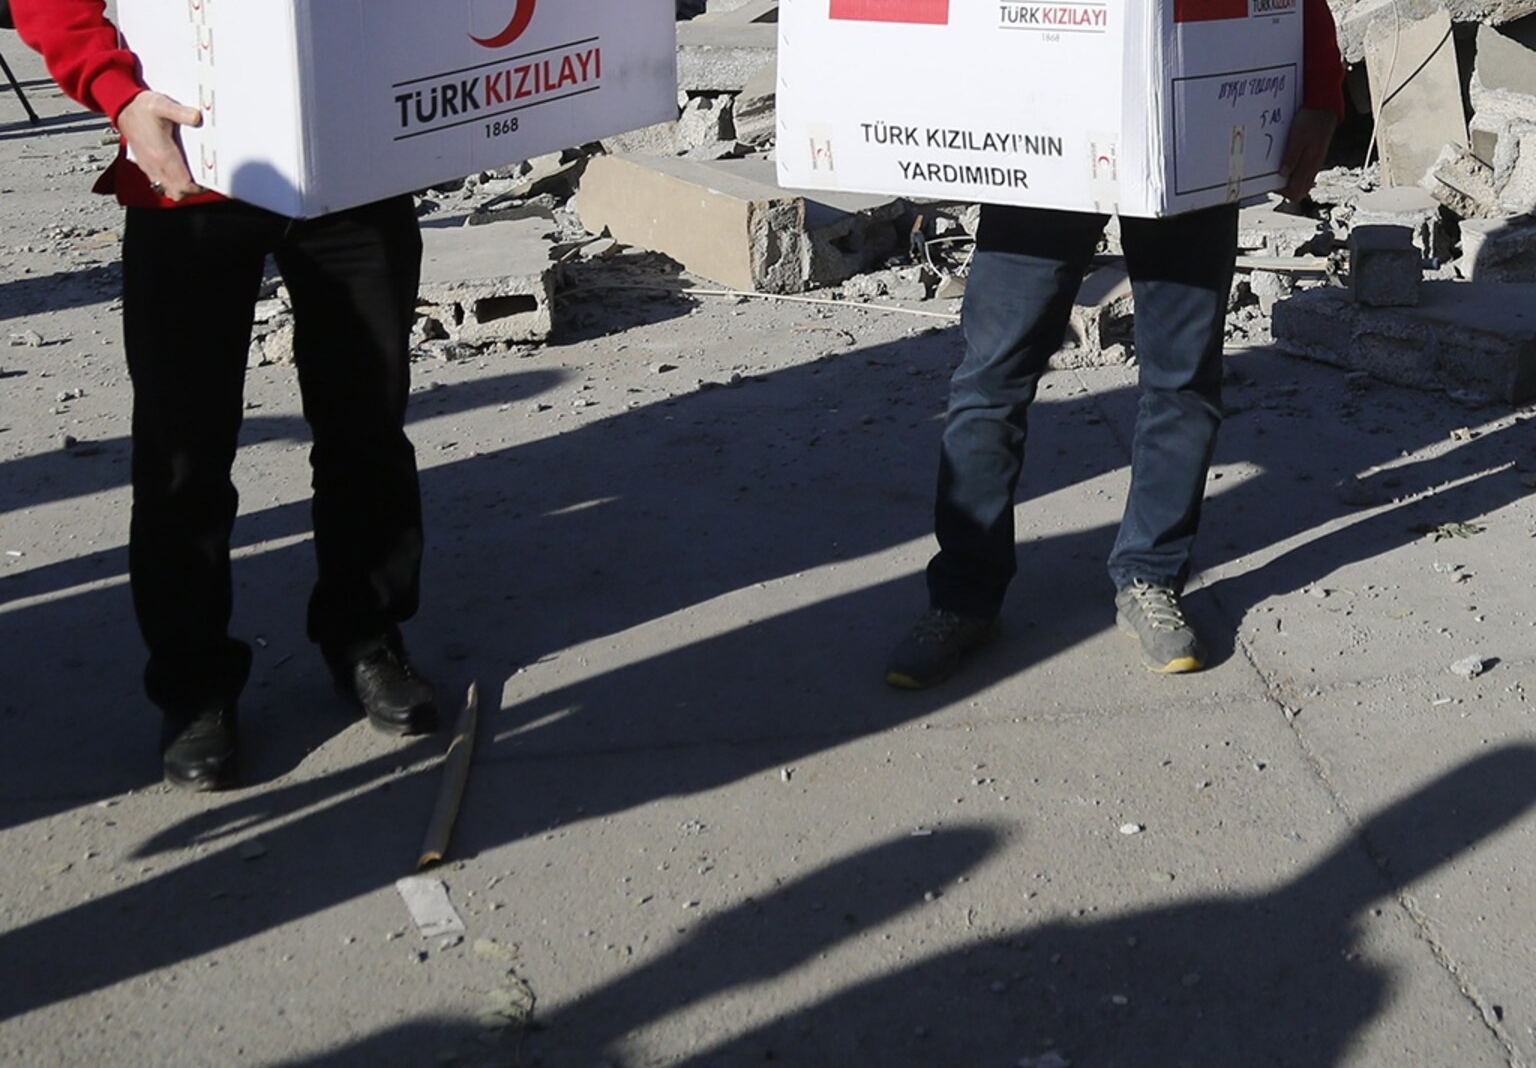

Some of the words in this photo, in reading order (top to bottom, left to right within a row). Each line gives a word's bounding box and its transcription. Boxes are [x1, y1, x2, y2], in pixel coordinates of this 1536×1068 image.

[1000, 6, 1039, 24] TÜRK
[1042, 7, 1107, 26] KIZILAYI
[395, 77, 480, 128] TÜRK
[485, 48, 601, 107] KIZILAYI
[485, 117, 519, 138] 1868
[861, 121, 918, 146] TÜRK
[927, 128, 1063, 157] KIZILAYI'NIN
[898, 161, 1029, 188] YARDIMIDIR
